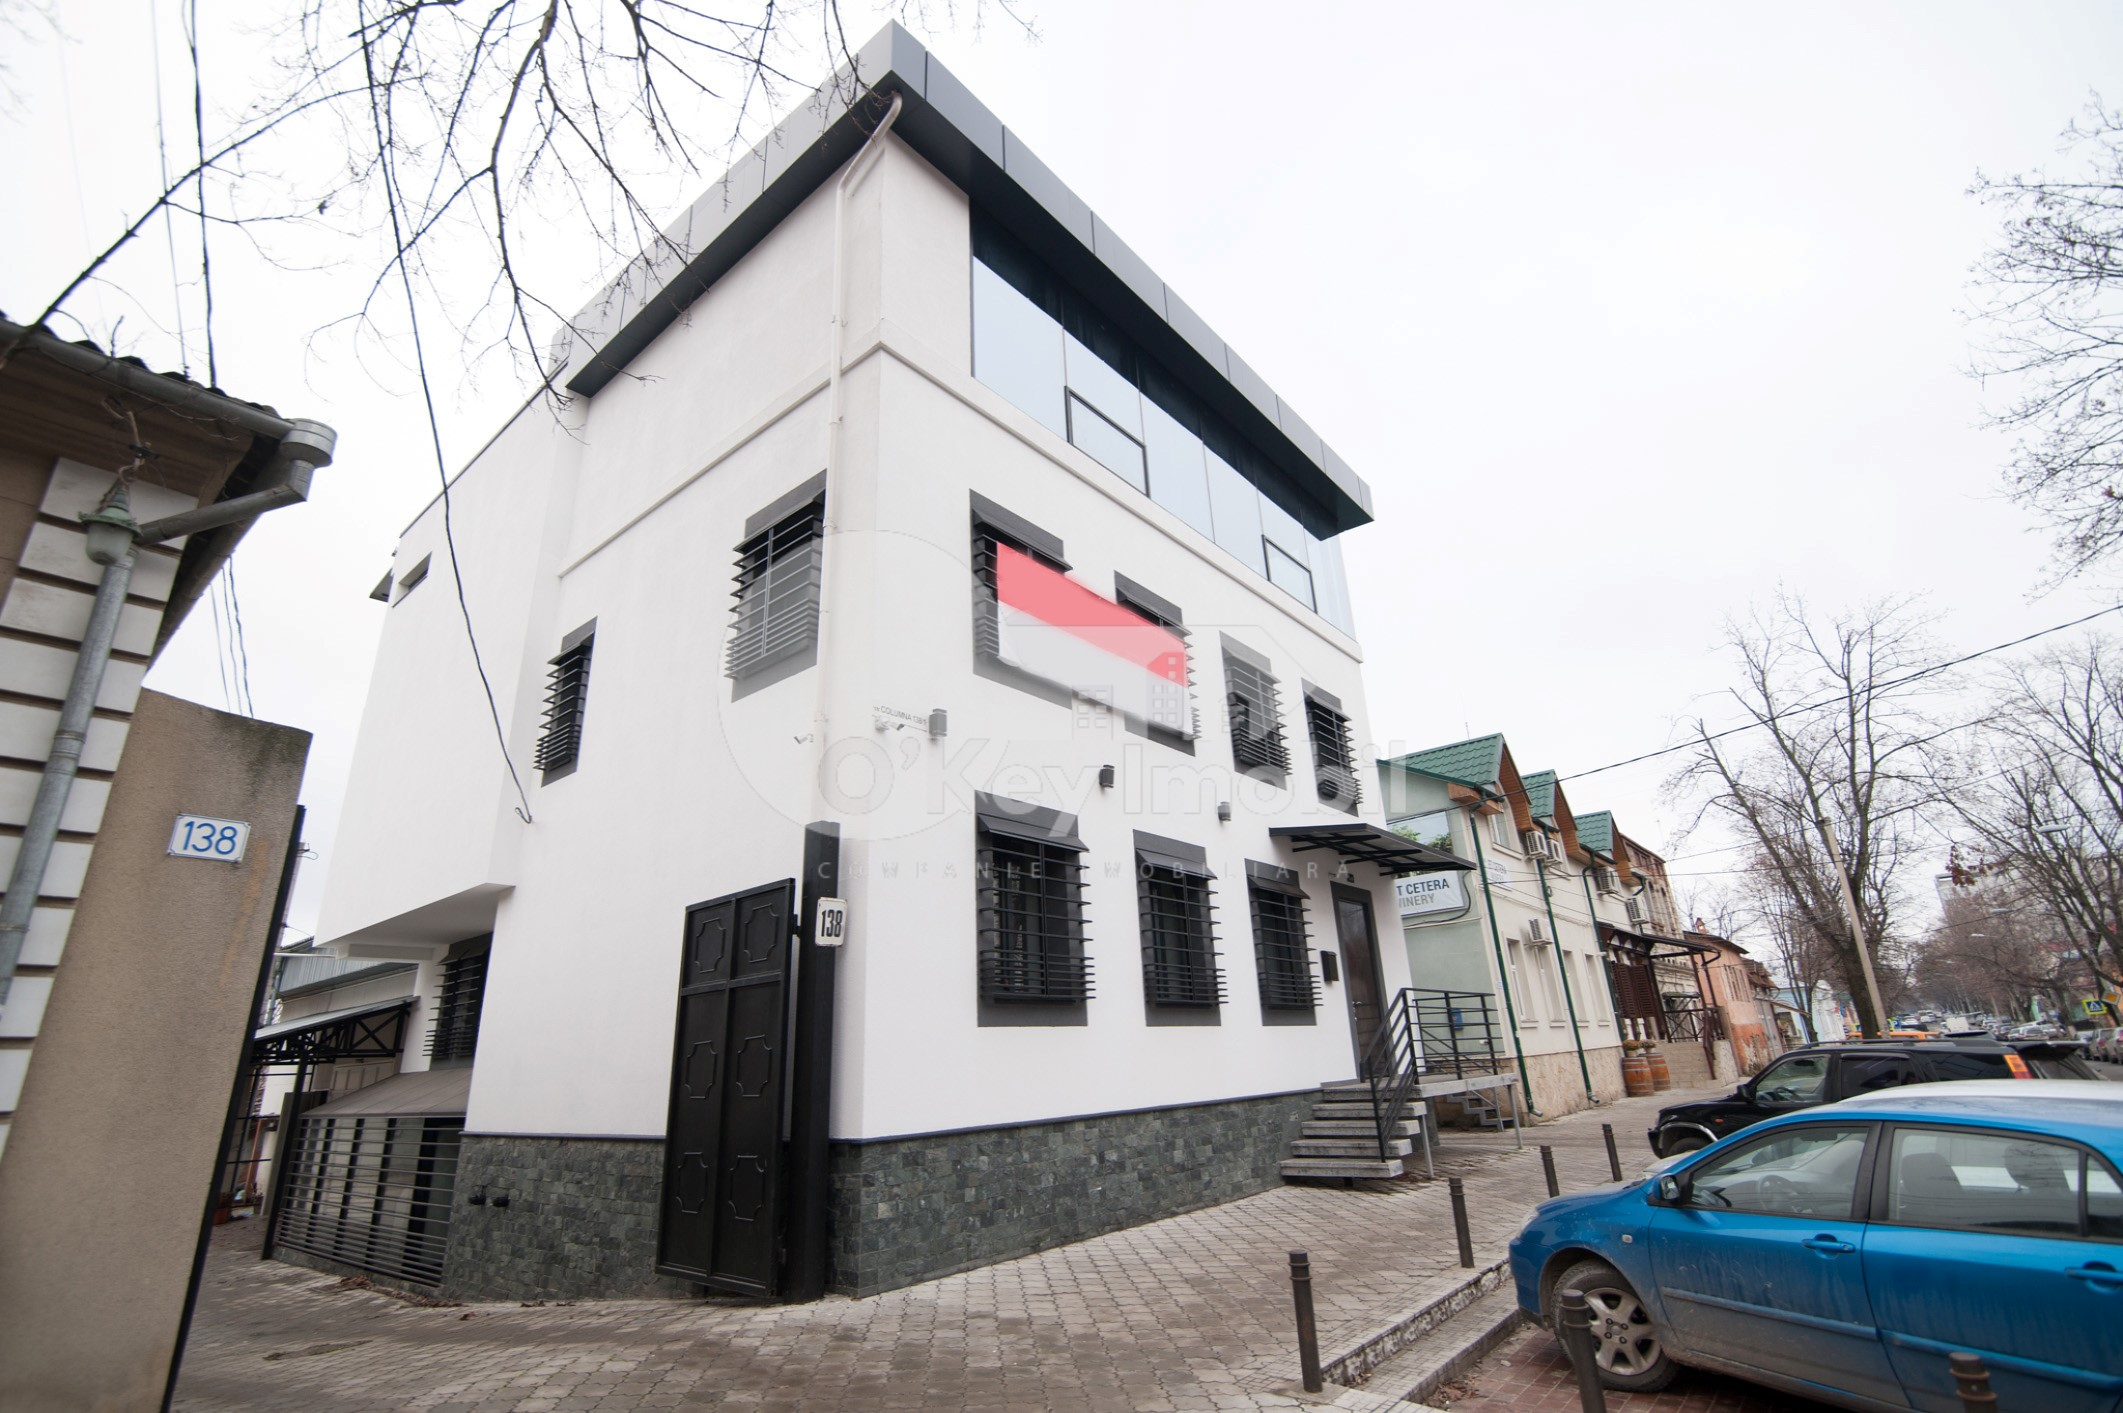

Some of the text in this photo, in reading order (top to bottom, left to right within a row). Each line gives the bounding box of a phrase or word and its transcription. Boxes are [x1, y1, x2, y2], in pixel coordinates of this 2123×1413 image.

[183, 820, 238, 855] 138
[1406, 878, 1450, 895] CETERA
[821, 909, 843, 937] 138
